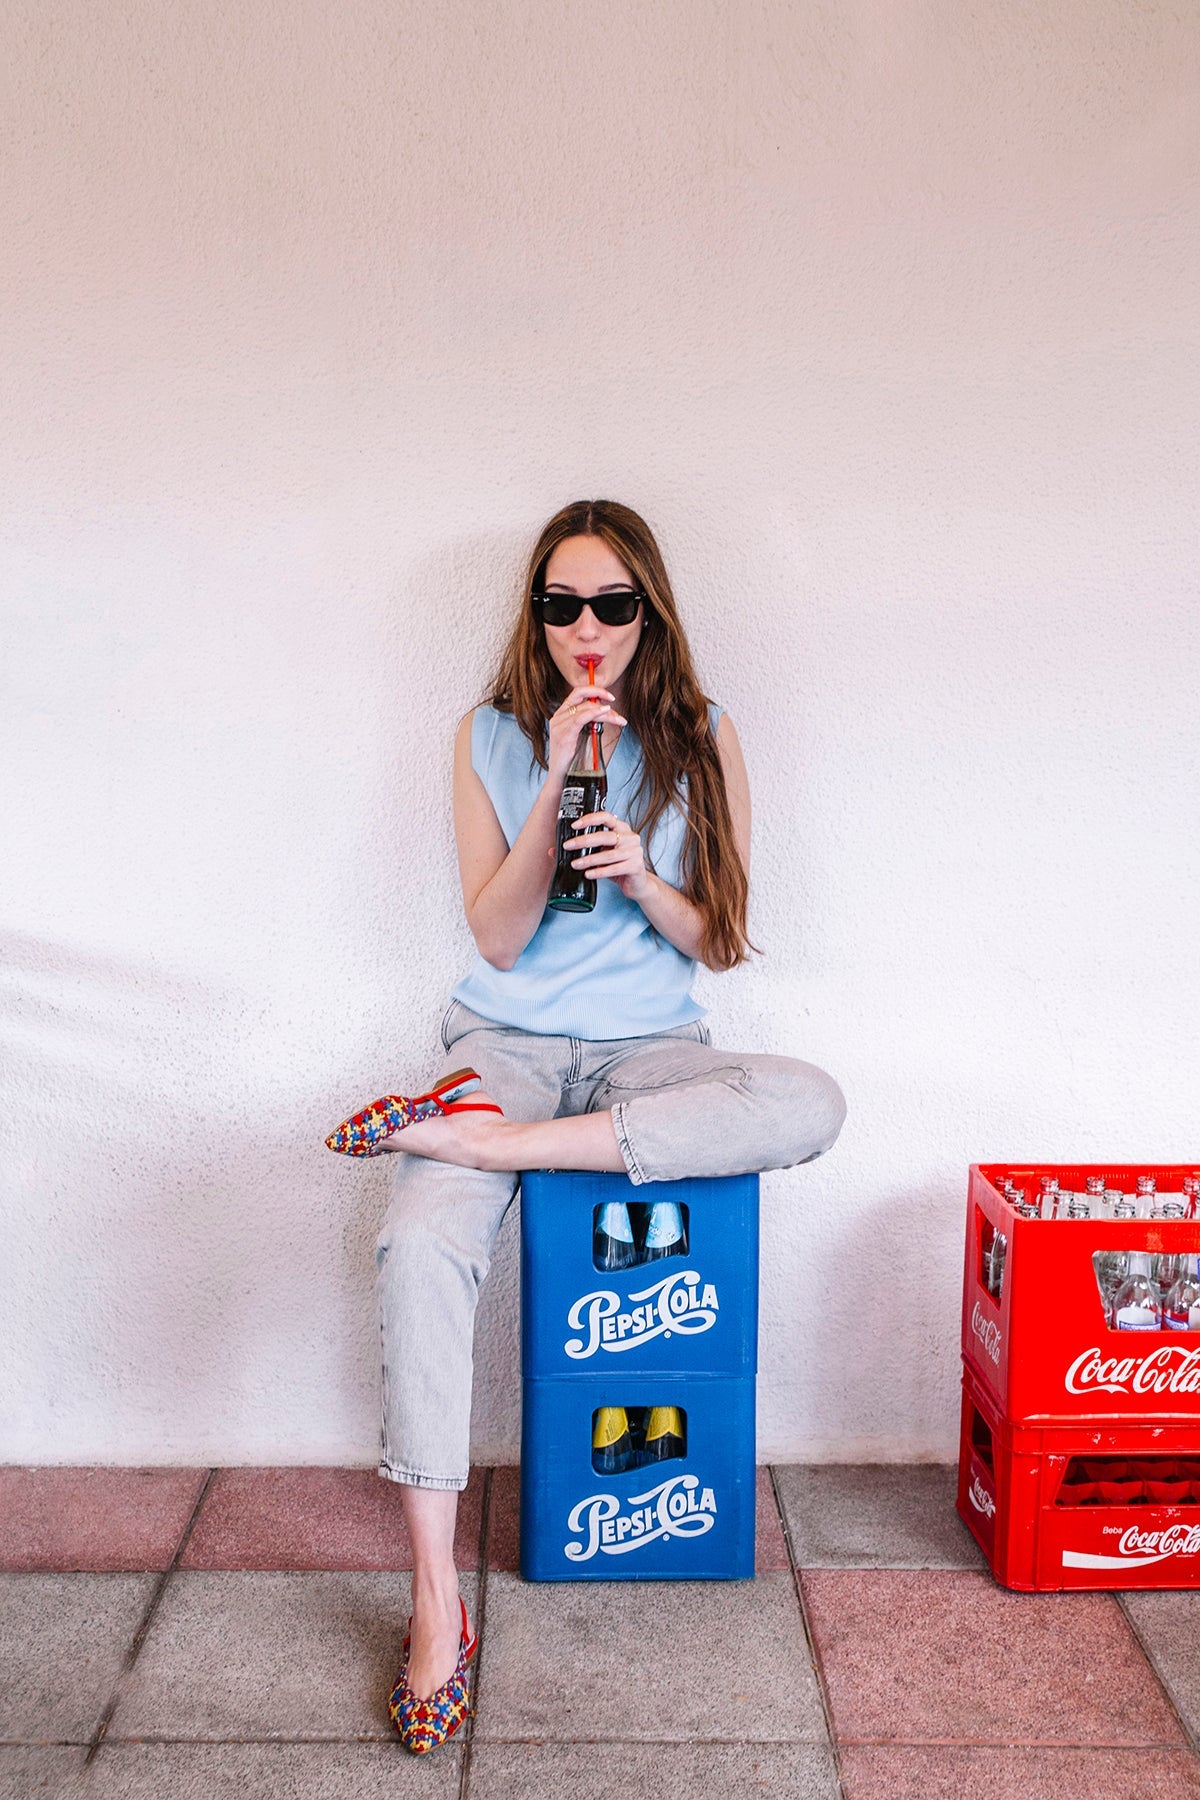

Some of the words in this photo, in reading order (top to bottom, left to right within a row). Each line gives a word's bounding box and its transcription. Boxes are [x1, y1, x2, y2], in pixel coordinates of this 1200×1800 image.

[1065, 1346, 1200, 1394] Coca-Cola
[1102, 1526, 1122, 1534] Beba
[1118, 1524, 1200, 1554] Coca-Cola
